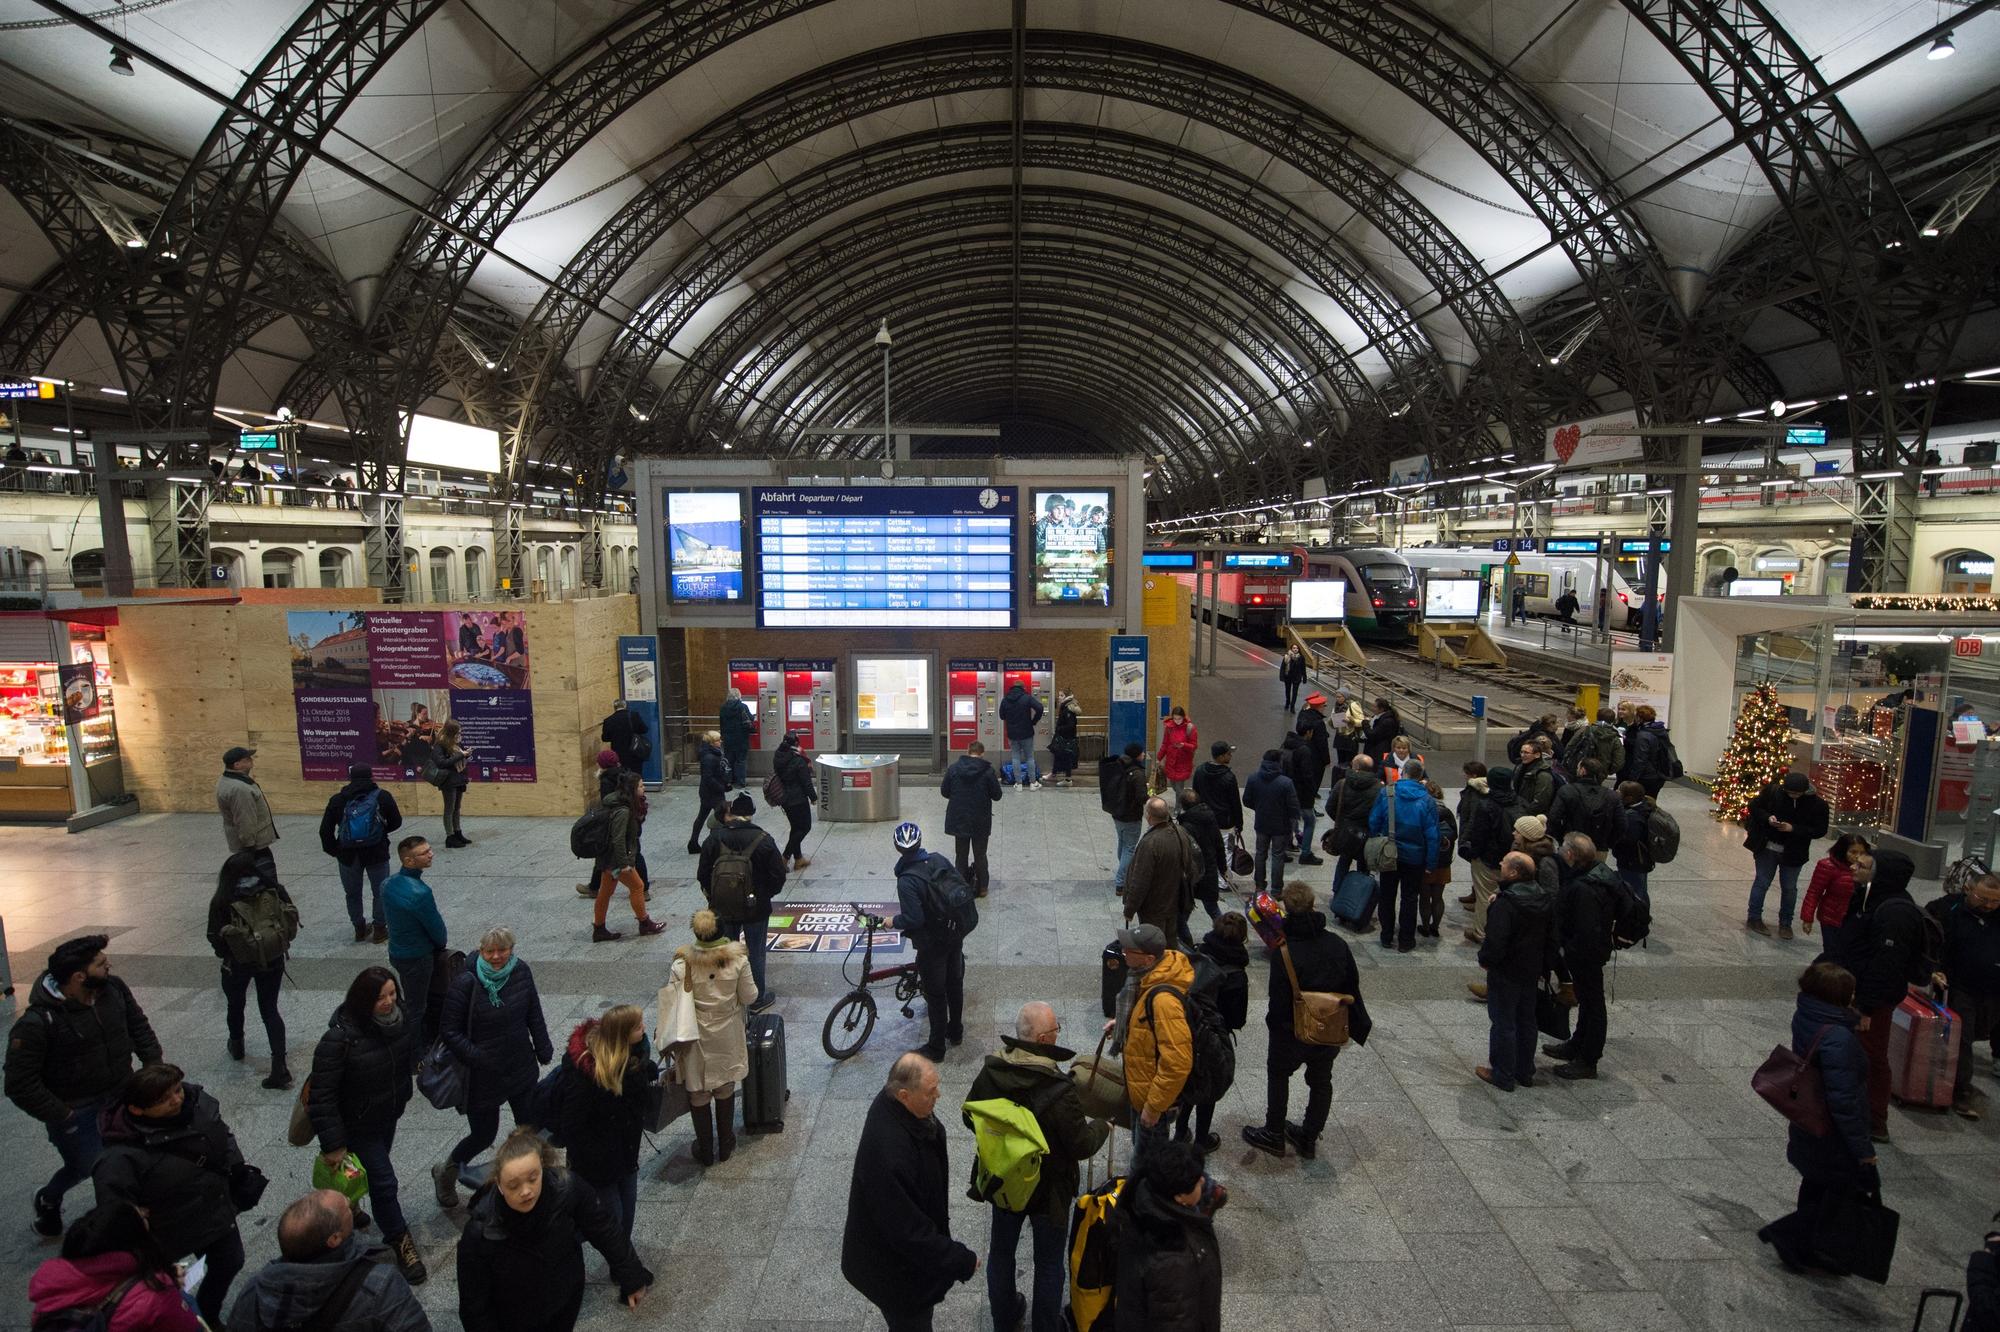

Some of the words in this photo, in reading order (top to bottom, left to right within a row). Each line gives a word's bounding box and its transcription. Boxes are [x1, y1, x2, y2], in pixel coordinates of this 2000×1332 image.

[760, 492, 796, 502] Abfahrt
[799, 494, 835, 503] Departure
[836, 494, 840, 502] /
[841, 494, 863, 503] Départ
[1497, 540, 1508, 550] 13
[1521, 540, 1532, 550] 14
[1281, 556, 1289, 564] 12
[216, 566, 224, 578] 6
[1960, 641, 1979, 653] DB
[821, 778, 829, 810] Abfall
[803, 914, 852, 923] back
